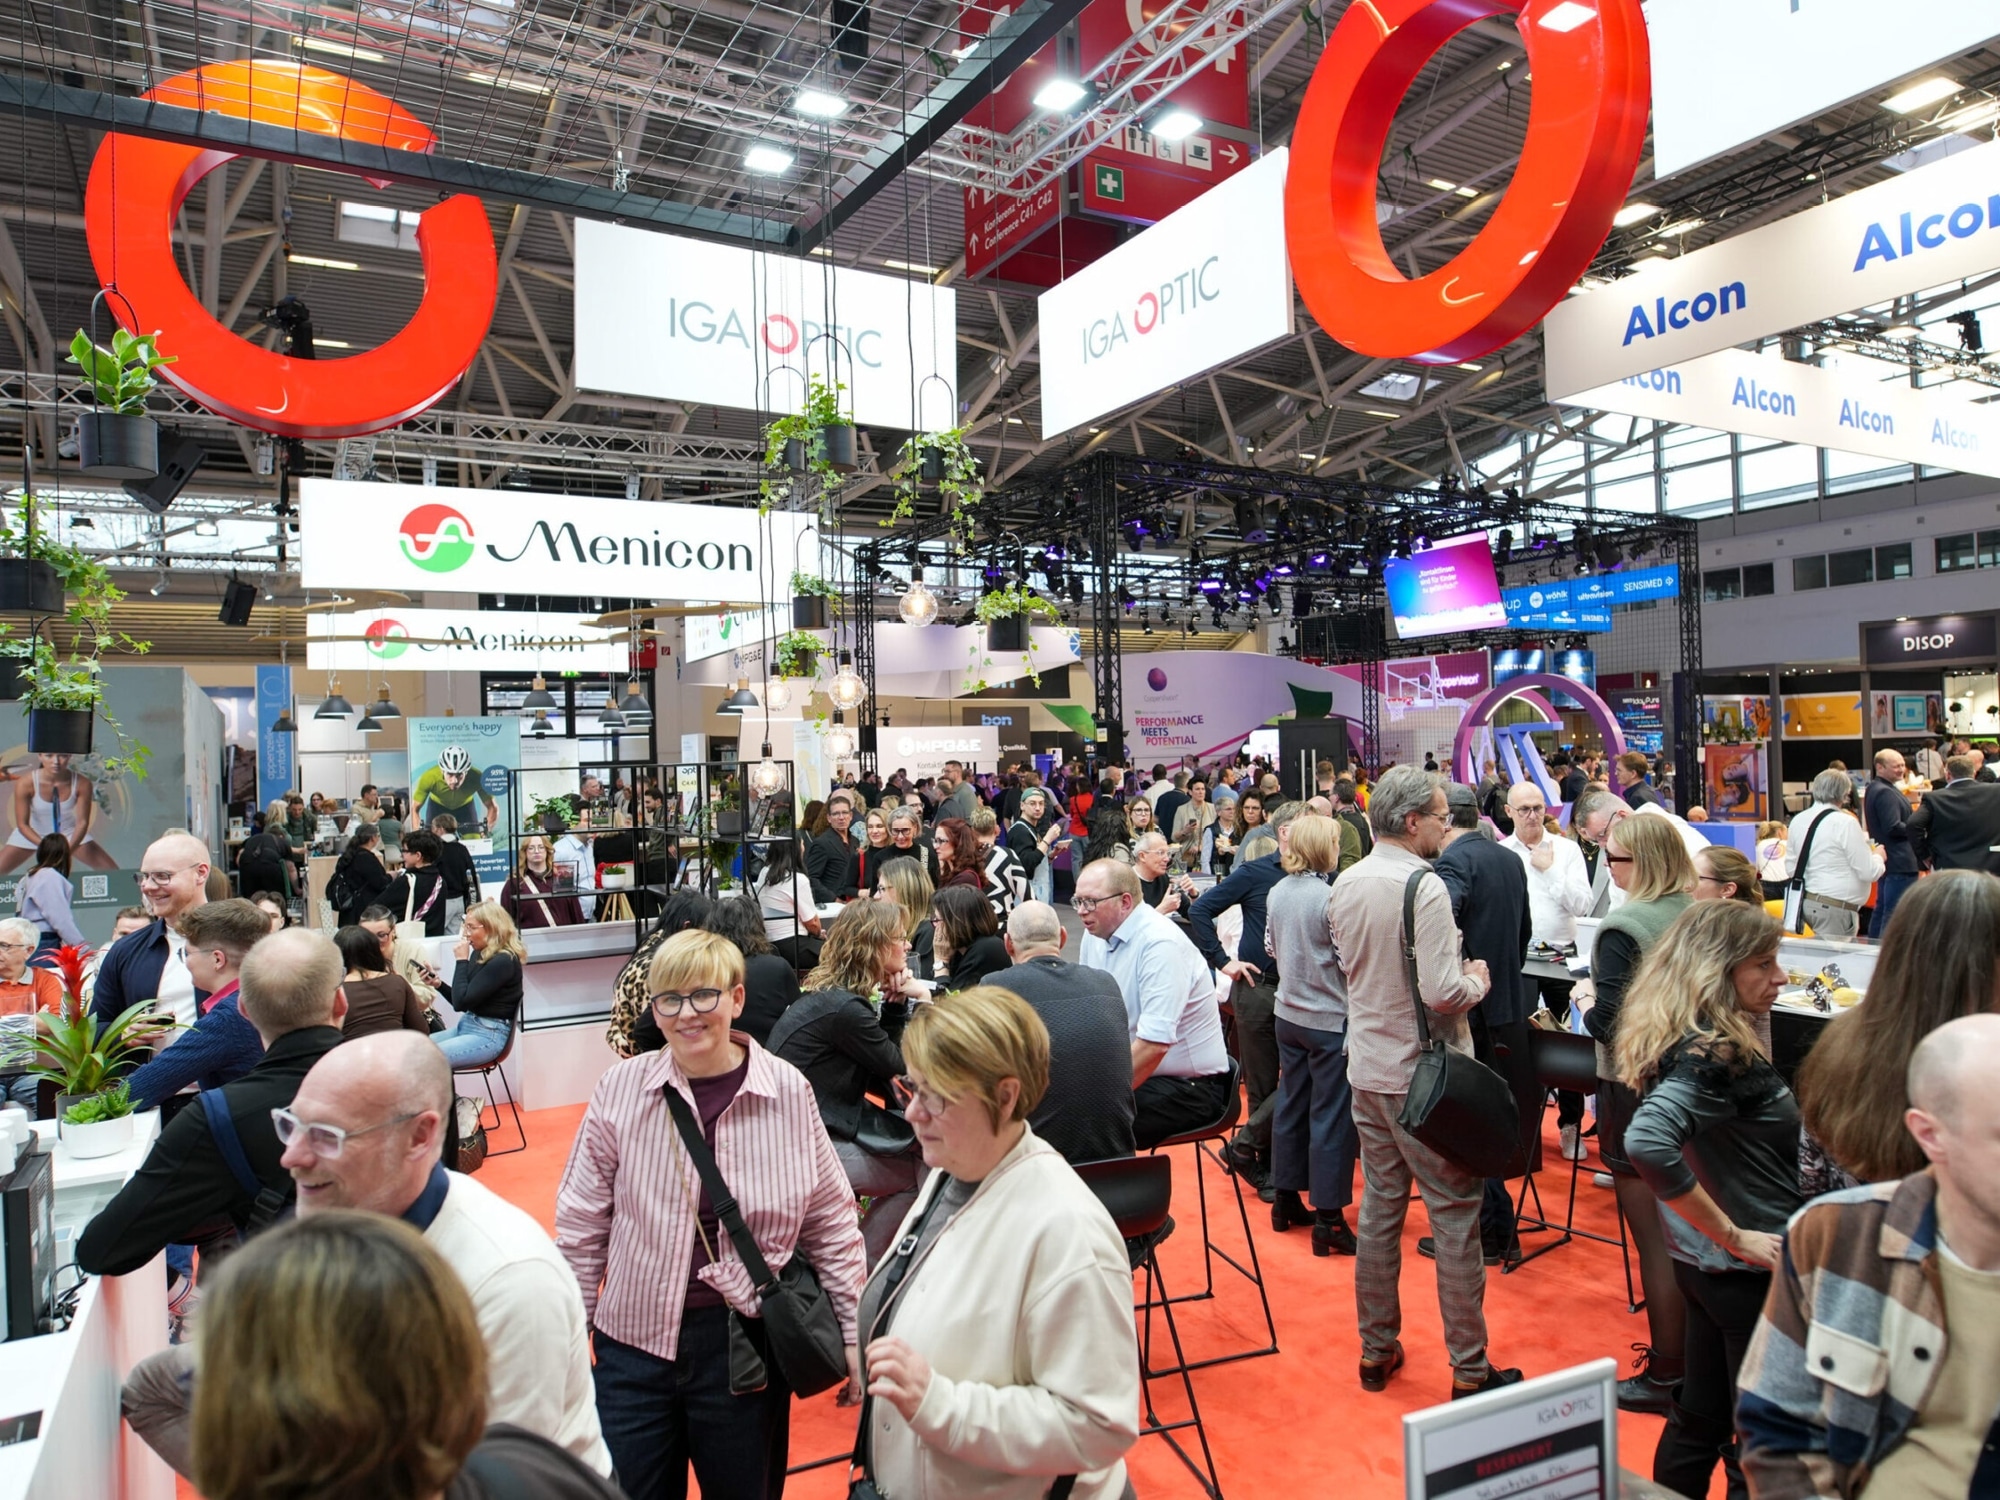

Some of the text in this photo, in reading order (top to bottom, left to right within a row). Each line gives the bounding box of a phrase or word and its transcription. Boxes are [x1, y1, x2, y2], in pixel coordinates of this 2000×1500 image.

[984, 204, 1016, 234] Konferenz
[984, 218, 1020, 250] Conference
[1020, 204, 1037, 223] C41,
[1037, 189, 1053, 210] C42
[1083, 256, 1220, 364] IGA OPTIC
[1622, 281, 1746, 347] Alcon
[670, 297, 882, 368] IGA OPTIC
[1732, 376, 1796, 416] Alcon
[1839, 398, 1894, 435] Alcon
[1931, 417, 1980, 451] Alcon
[486, 520, 753, 572] Menicon
[1545, 590, 1568, 600] wöhlk
[1577, 590, 1614, 601] ultravision
[1623, 579, 1662, 592] SENSIMED
[418, 626, 585, 652] Menicon
[1903, 634, 1954, 651] DISOP
[472, 722, 502, 737] happy
[981, 714, 1012, 726] bon
[1135, 714, 1204, 727] PERFORMANCE
[1141, 727, 1169, 736] MEETS
[916, 739, 982, 752] MPG&E
[1003, 744, 1028, 752] Qualität.
[1146, 735, 1198, 746] POTENTIAL
[276, 731, 287, 780] kontaktlin
[917, 762, 946, 770] Kontaktli
[1538, 1396, 1596, 1425] IGA OPTIC
[1476, 1441, 1553, 1477] RESERVIERT
